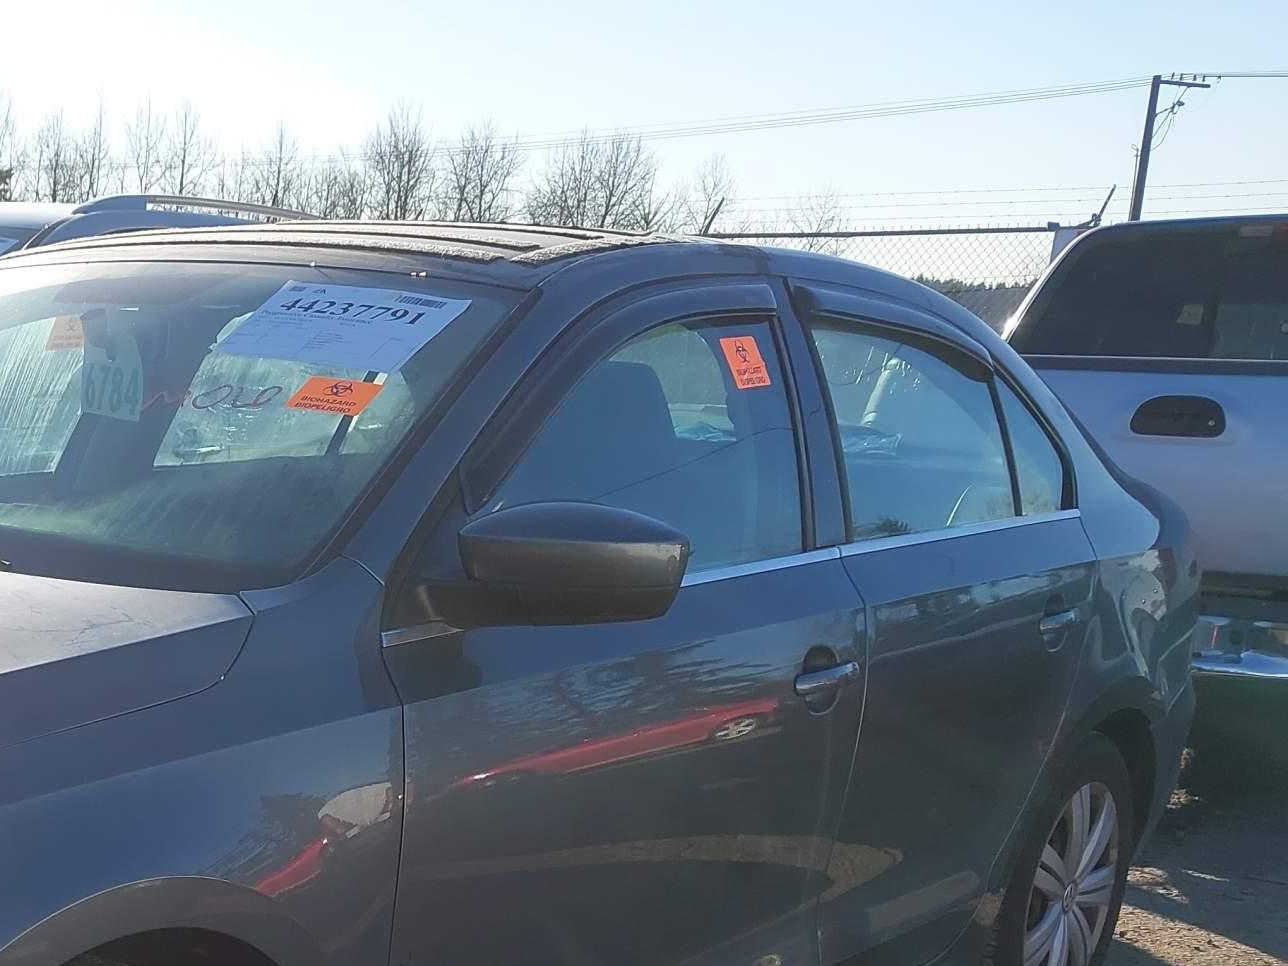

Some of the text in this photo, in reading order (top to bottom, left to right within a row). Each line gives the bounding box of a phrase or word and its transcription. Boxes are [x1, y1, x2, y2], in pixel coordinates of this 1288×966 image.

[280, 297, 427, 325] 44237791
[85, 362, 139, 415] 6784
[295, 402, 351, 414] BIOPELIGRO
[300, 395, 358, 408] BIOHAZARD
